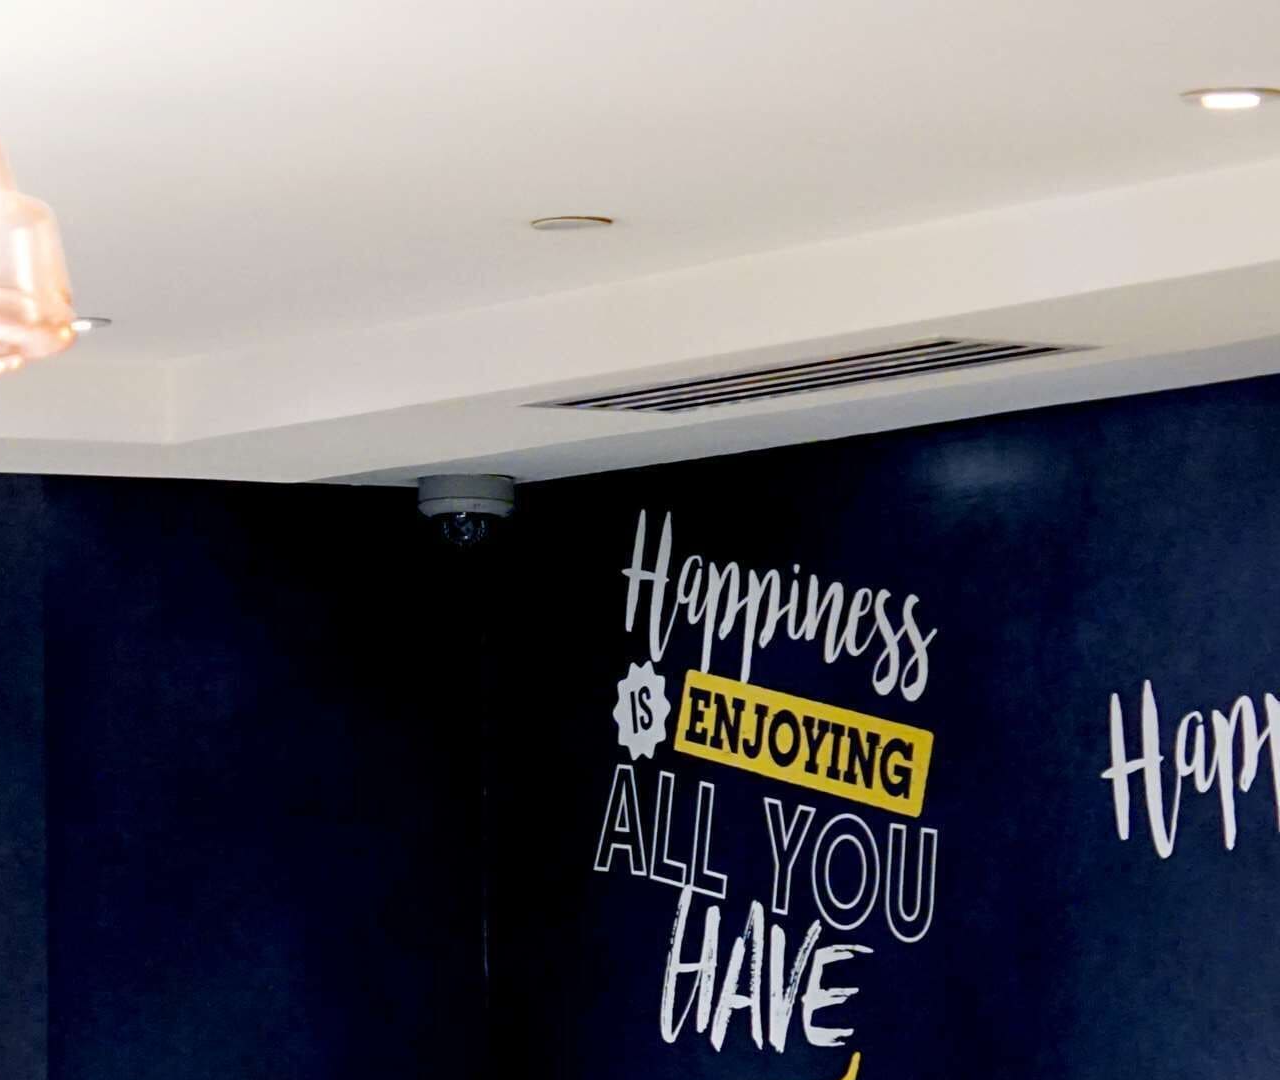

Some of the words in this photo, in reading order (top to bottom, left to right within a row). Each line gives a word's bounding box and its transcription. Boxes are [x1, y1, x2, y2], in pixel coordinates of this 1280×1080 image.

[621, 508, 937, 702] Happiness
[630, 685, 653, 734] IS
[683, 686, 915, 800] ENJOYING
[593, 764, 728, 900] ALL
[763, 796, 938, 943] YOU
[659, 884, 875, 1054] HAVE
